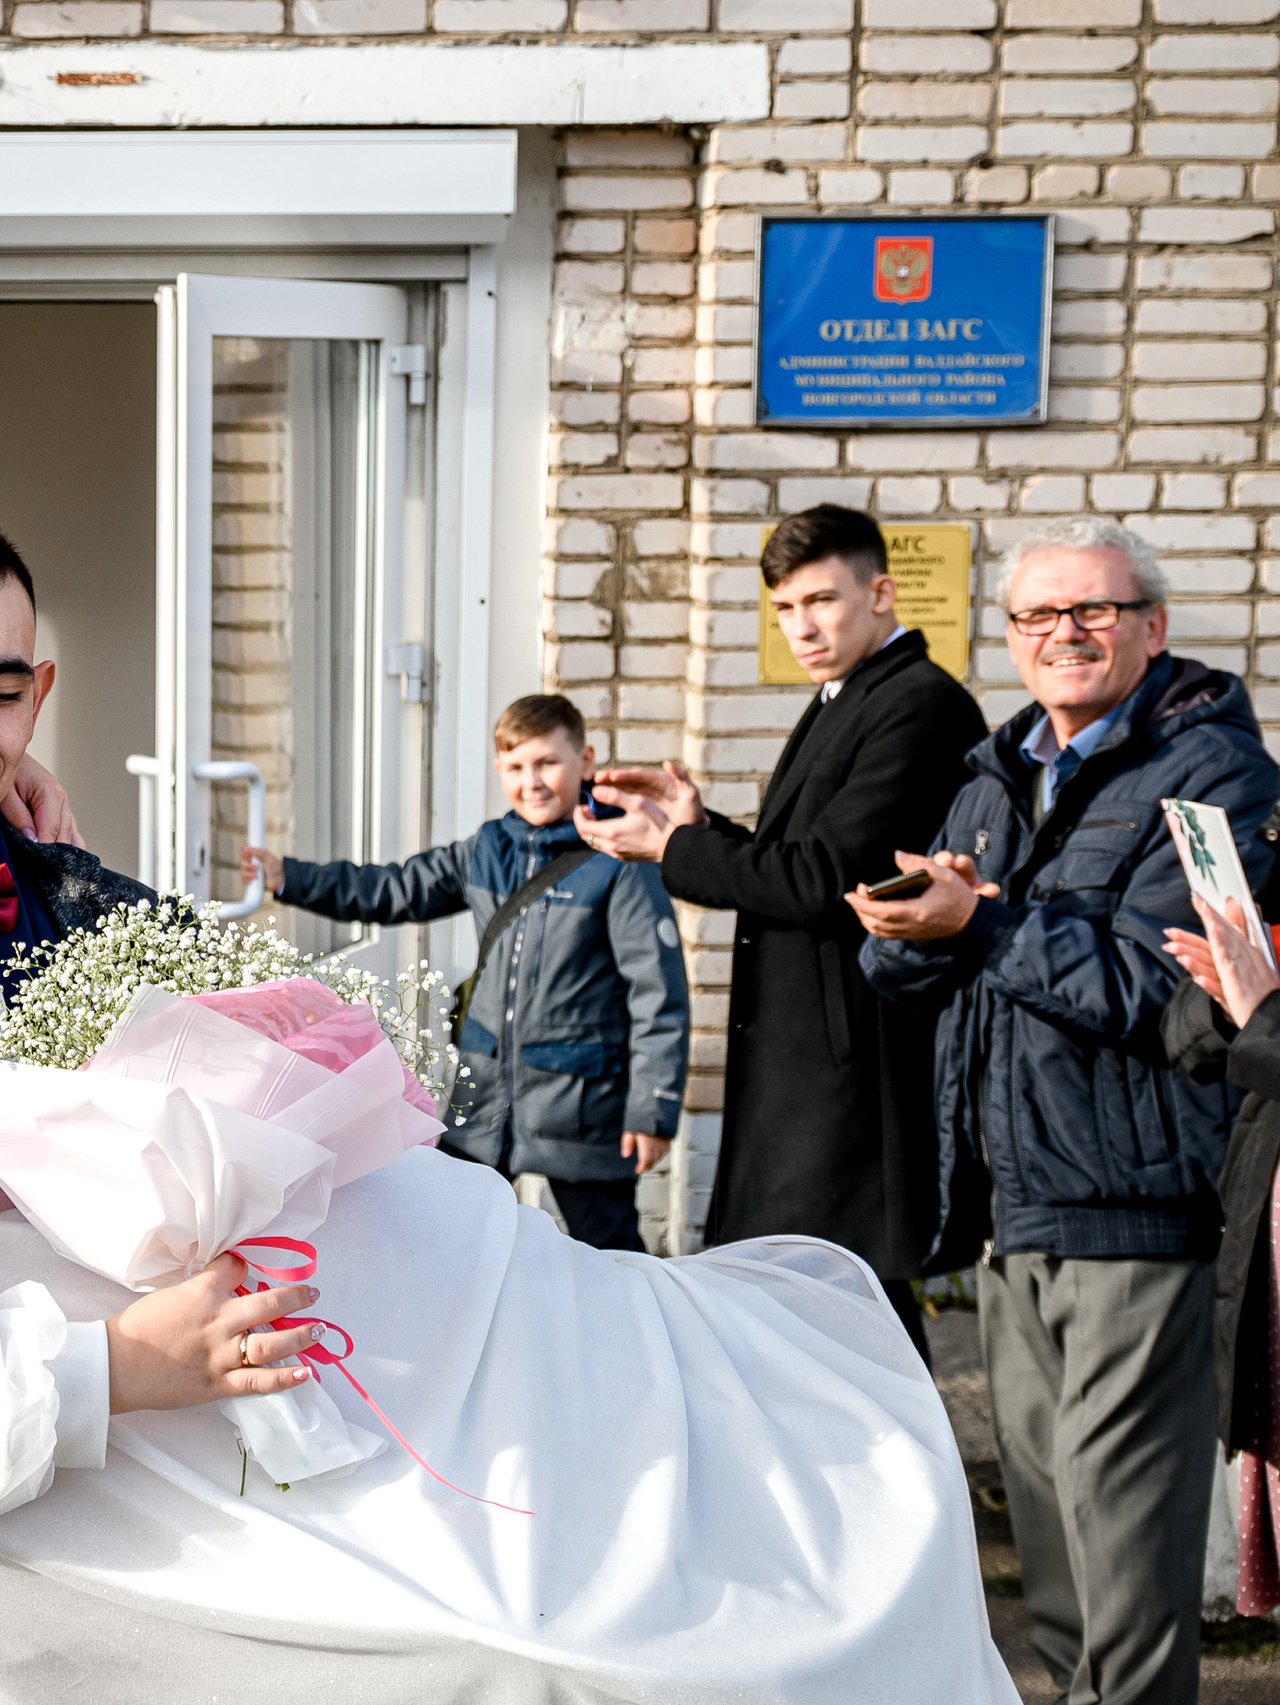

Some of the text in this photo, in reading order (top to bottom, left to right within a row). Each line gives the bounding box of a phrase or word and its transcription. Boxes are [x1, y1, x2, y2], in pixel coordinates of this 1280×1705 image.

[819, 318, 983, 342] ОТДЕЛ ЗАГС
[779, 354, 910, 370] АДМИНИСТРАЦИИ
[794, 371, 1006, 387] МУНИЦИПАЛЬНОГО РАЙОНА
[801, 390, 997, 406] НОВГОРОДСКОЙ ОБЛАСТИ
[886, 535, 927, 553] АГС
